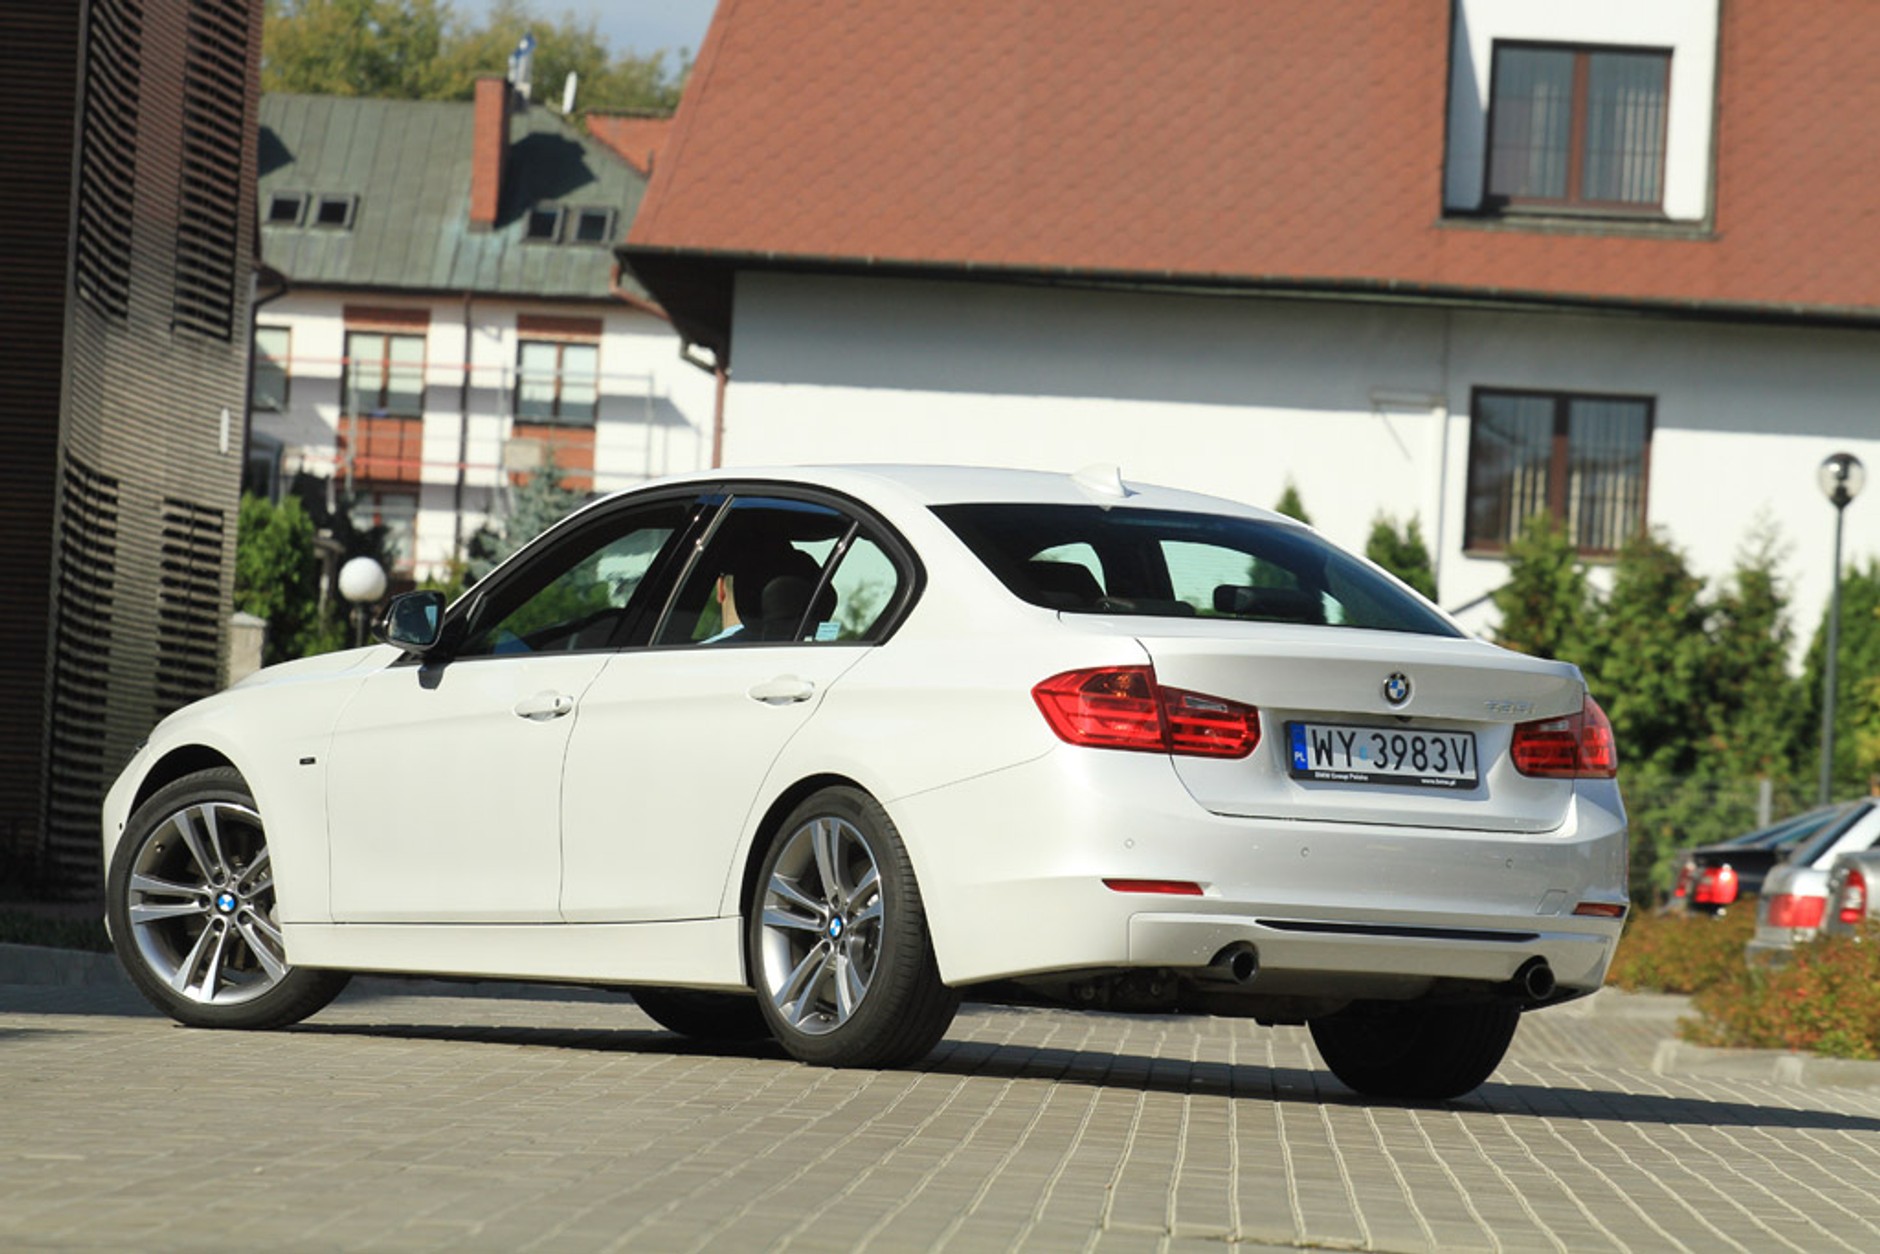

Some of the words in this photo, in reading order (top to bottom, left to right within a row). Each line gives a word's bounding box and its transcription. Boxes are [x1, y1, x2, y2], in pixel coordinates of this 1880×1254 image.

[1294, 751, 1306, 762] PL
[1312, 729, 1356, 767] WY
[1371, 733, 1468, 774] 3983V
